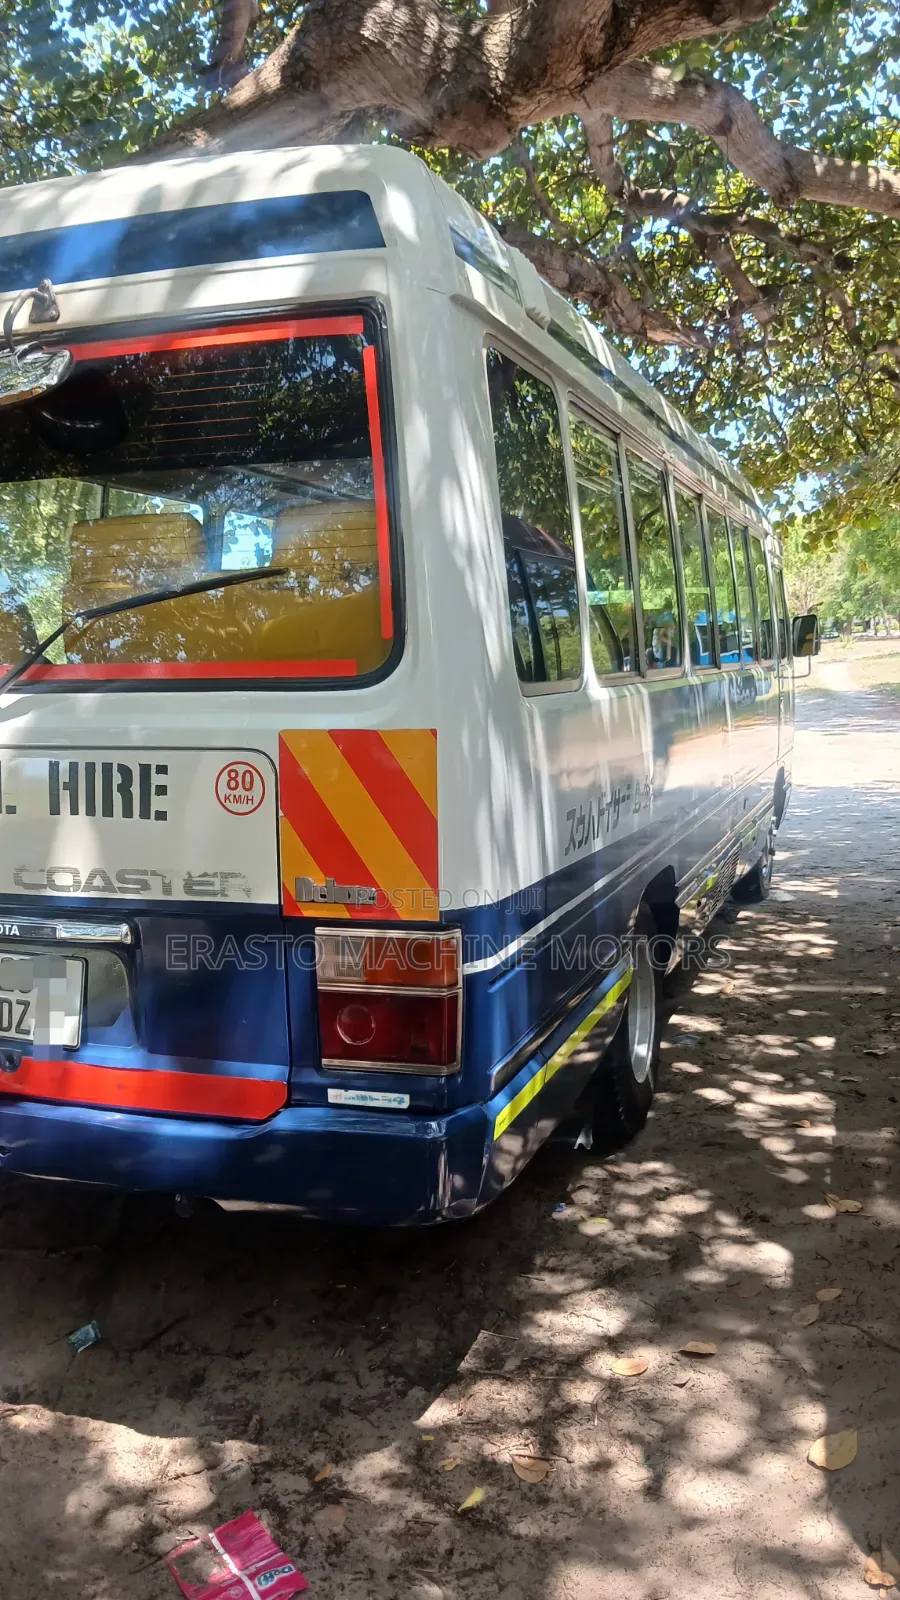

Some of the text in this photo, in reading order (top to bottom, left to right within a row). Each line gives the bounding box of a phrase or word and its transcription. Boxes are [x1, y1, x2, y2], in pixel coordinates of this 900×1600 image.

[49, 761, 168, 821] HIRE
[226, 768, 255, 792] 80
[223, 793, 255, 805] KM/H
[13, 865, 252, 898] COASTER
[0, 997, 34, 1036] DZ
